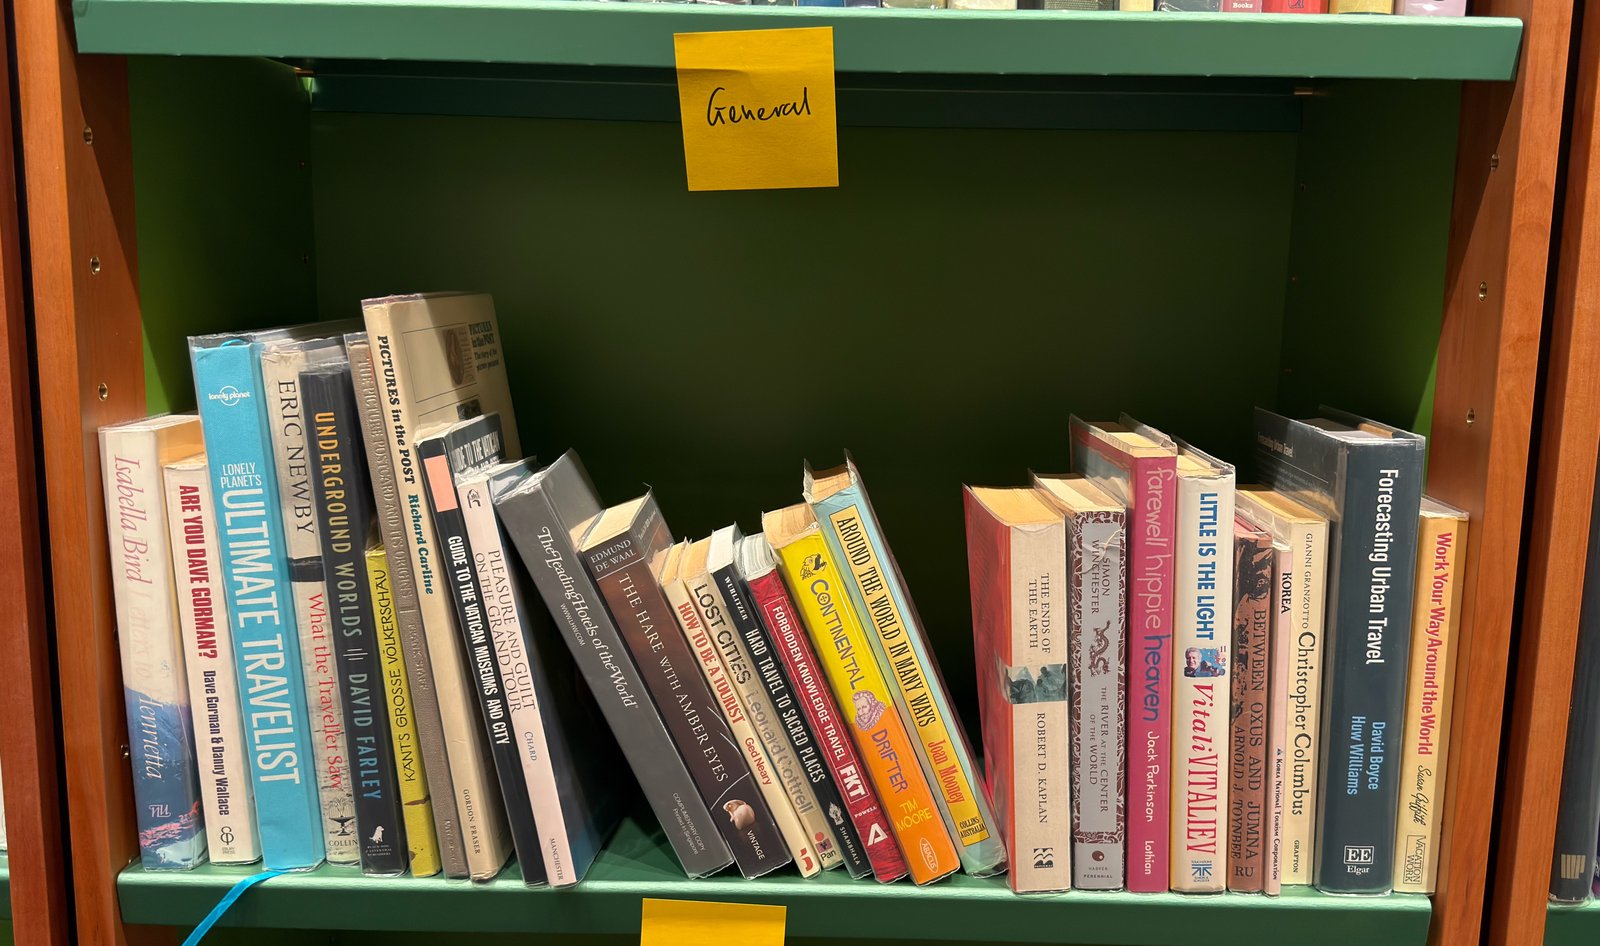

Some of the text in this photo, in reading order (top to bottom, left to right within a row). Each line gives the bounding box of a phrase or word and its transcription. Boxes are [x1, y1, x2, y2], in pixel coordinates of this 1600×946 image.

[707, 87, 811, 126] General
[208, 390, 251, 402] lonely planet
[377, 335, 416, 485] PICTURES in the POST
[220, 475, 262, 489] PLANET'S
[222, 462, 256, 476] LONELY
[277, 379, 315, 535] ERIC NEWBY
[114, 455, 153, 584] Isabella Bird
[314, 411, 363, 638] UNDERGROUND WORLDS
[408, 494, 434, 596] Richard Carline
[590, 539, 631, 564] EDMUND
[179, 485, 218, 659] ARE YOU DAVE GORMAN?
[724, 575, 749, 622] WURLITZER
[1091, 539, 1100, 615] WINCHESTER
[1102, 557, 1111, 597] SIMON
[1137, 467, 1175, 722] farewell hippie heaven
[1196, 492, 1218, 641] LITTLE IS THE LIGHT
[1281, 571, 1292, 615] KOREA
[1302, 533, 1313, 629] GIANNI GRANZOTTO
[1366, 469, 1399, 665] Forecasting Urban Travel
[222, 488, 300, 785] ULTIMATE TRAVELIST
[448, 535, 510, 745] GUIDE TO THE VATICAN MUSEUMS AND CITY
[474, 552, 522, 713] ON THE GRAND TOUR
[488, 550, 536, 710] PLEASURE AND GUILT
[694, 583, 752, 685] LOST CITIES
[836, 516, 937, 729] AROUND THE WORLD IN MANY WAYS
[1028, 578, 1039, 649] THE EARTH
[1040, 572, 1051, 654] THE ENDS OF
[1417, 532, 1452, 756] Work Your Way Around the World
[307, 592, 344, 789] What the Traveller Saw
[619, 573, 729, 783] THE HARE WITH AMBER EYES
[677, 601, 746, 725] HOW TO BE A TOURIST
[772, 605, 847, 761] FORBIDDEN KNOWLEDGE TRAVEL
[810, 578, 909, 795] CONTINENTAL DRIFTER
[349, 673, 382, 800] DAVID FARLEY
[745, 628, 827, 784] HARD TRAVEL TO SACRED PLACES
[1101, 704, 1109, 737] RIVER
[1191, 683, 1214, 753] Vitali
[1245, 608, 1266, 860] BETWEEN OXUS AND JUMNA
[1289, 631, 1316, 816] Christopher Columbus
[203, 671, 230, 816] Dave Gorman & Danny Wallace
[744, 737, 773, 786] Ged Neary
[927, 738, 965, 806] Joan Mooney
[1036, 712, 1048, 824] ROBERT D. KAPLAN
[1101, 739, 1106, 749] AT
[1145, 731, 1160, 823] Jack Parkinson
[1346, 715, 1366, 796] Huw Williams
[1367, 721, 1386, 790] David Boyce
[839, 764, 867, 802] FKT
[854, 805, 878, 819] POWELL
[896, 807, 933, 832] MOORE
[899, 798, 919, 815] TIM
[1100, 769, 1109, 813] CENTER
[1186, 753, 1219, 855] VITALIEV
[464, 788, 481, 855] GORDON FRASER
[747, 829, 766, 861] VINTAGE
[821, 850, 837, 862] Pan
[839, 826, 862, 867] SHAMBHALA
[921, 841, 938, 869] ABACUS
[959, 816, 980, 829] COLLINS
[960, 823, 986, 839] AUSTRALIA
[1144, 840, 1155, 875] Lothian
[1347, 847, 1372, 862] EE
[550, 837, 564, 881] MANCHESTER
[1347, 865, 1370, 876] Elgar
[1404, 854, 1415, 883] WORK
[1412, 834, 1427, 883] VACATION
